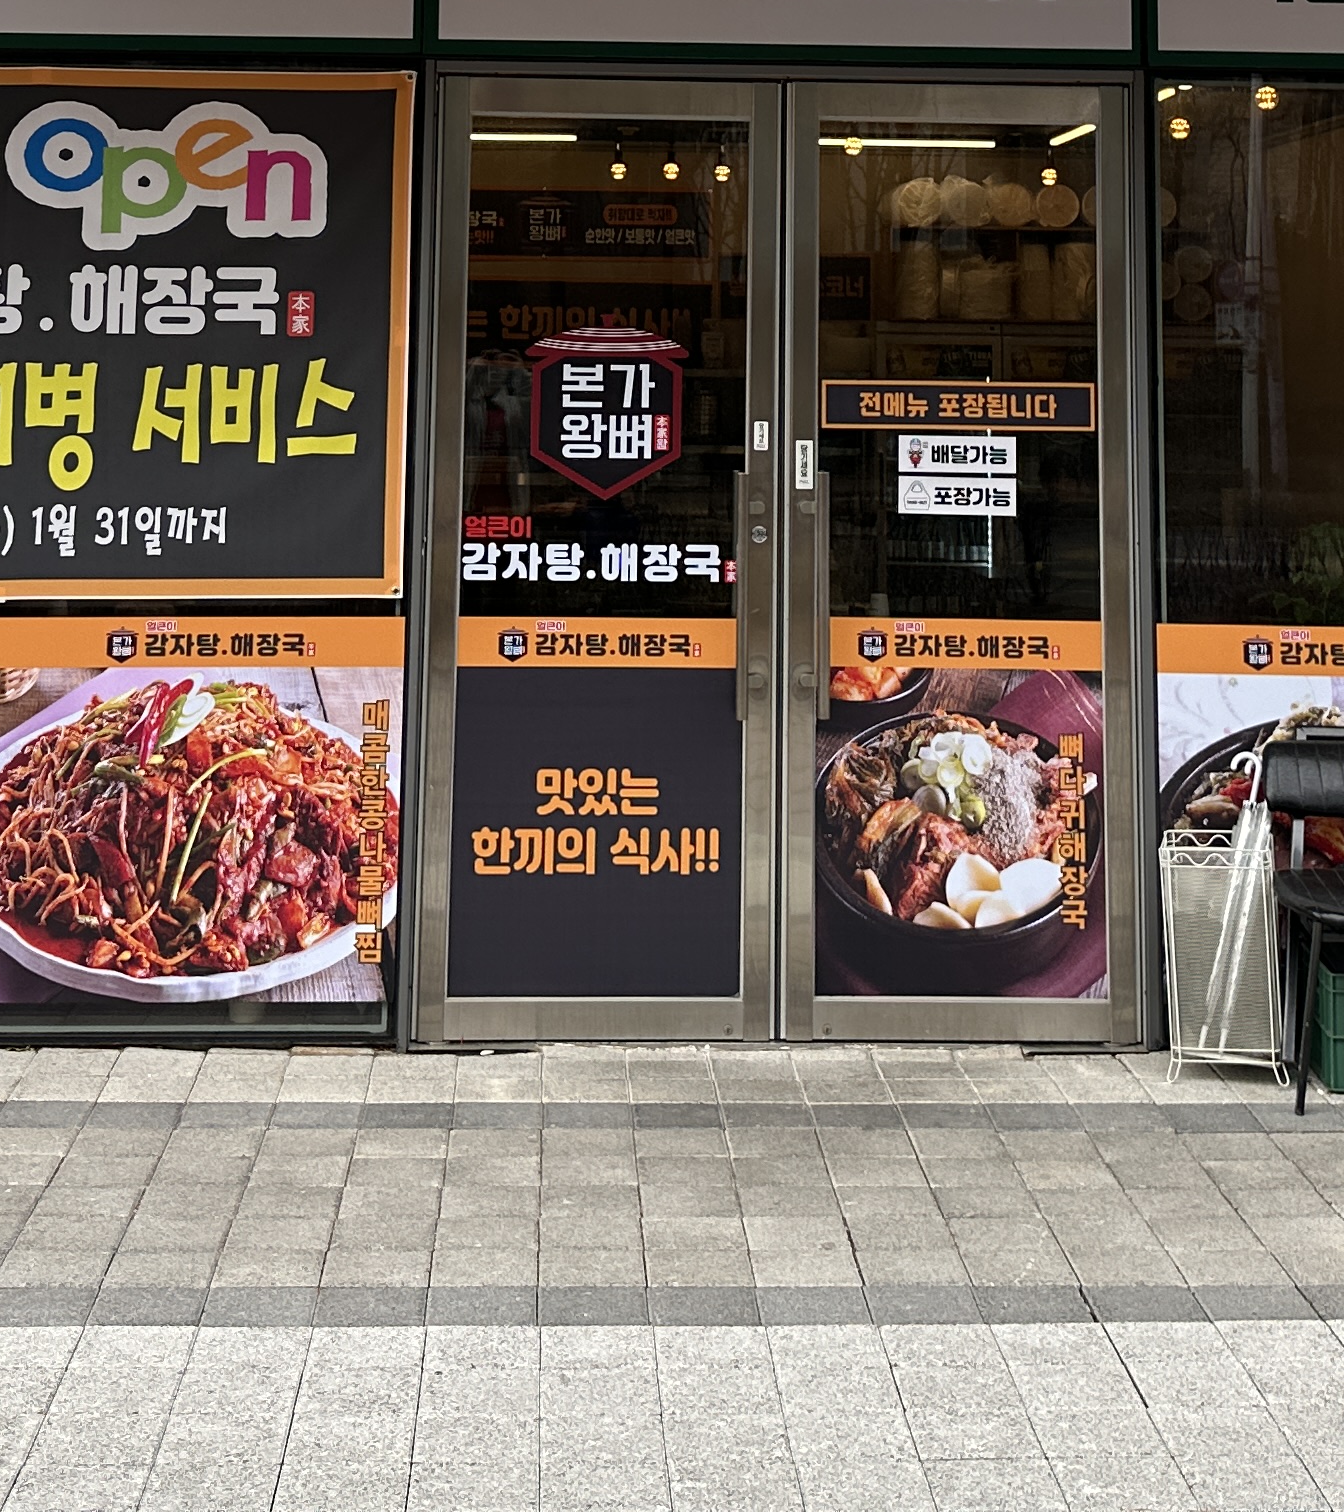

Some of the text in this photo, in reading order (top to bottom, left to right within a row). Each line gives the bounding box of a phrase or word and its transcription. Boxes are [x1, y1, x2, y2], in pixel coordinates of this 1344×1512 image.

[561, 363, 656, 409] 본가
[858, 391, 1058, 421] 전메뉴 포장됩니다
[131, 357, 358, 465] 서비스
[559, 413, 652, 460] 왕뼈
[931, 444, 1008, 465] 배달가능
[933, 486, 1011, 507] 포장가능
[30, 505, 78, 559] 1월
[94, 504, 229, 557] 31일까지
[464, 514, 532, 539] 얼큰이
[534, 766, 661, 817] 맛있는
[353, 698, 391, 965] 매콤한콩나물뼈찜
[470, 825, 722, 877] 한끼의 식사!!
[1057, 731, 1088, 932] 뼈다귀해장국
